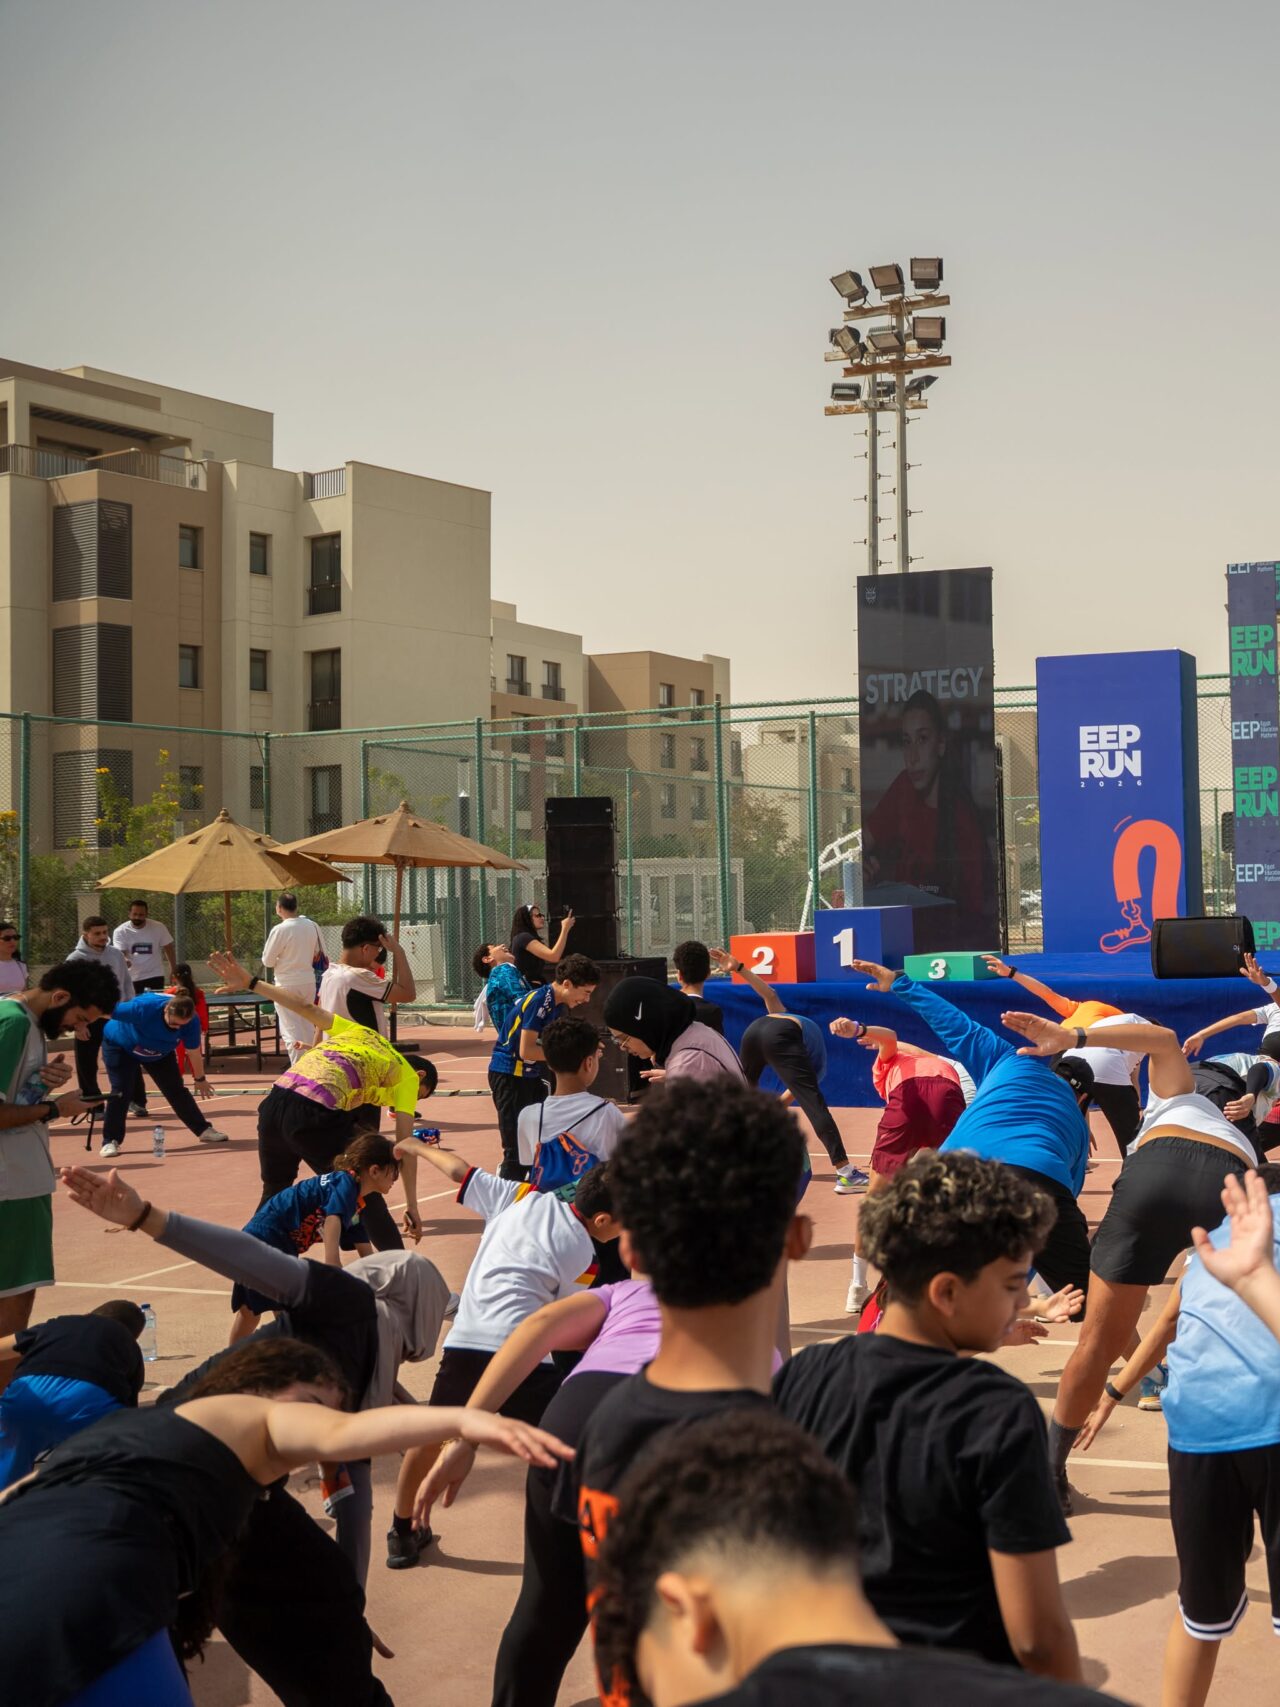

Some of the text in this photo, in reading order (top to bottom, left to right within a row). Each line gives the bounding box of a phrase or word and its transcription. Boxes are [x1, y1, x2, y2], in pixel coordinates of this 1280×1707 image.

[1230, 624, 1274, 650] EEP
[1231, 650, 1276, 676] RUN
[865, 667, 984, 704] STRATEGY
[1080, 724, 1140, 750] EEP
[1232, 720, 1260, 740] EEP
[1080, 750, 1142, 778] RUN
[1080, 780, 1142, 788] 2026
[1234, 766, 1278, 790] EEP
[1236, 791, 1278, 818] RUN
[1236, 864, 1264, 882] EEP
[750, 946, 774, 974] 2
[832, 928, 854, 966] 1
[928, 958, 946, 980] 3
